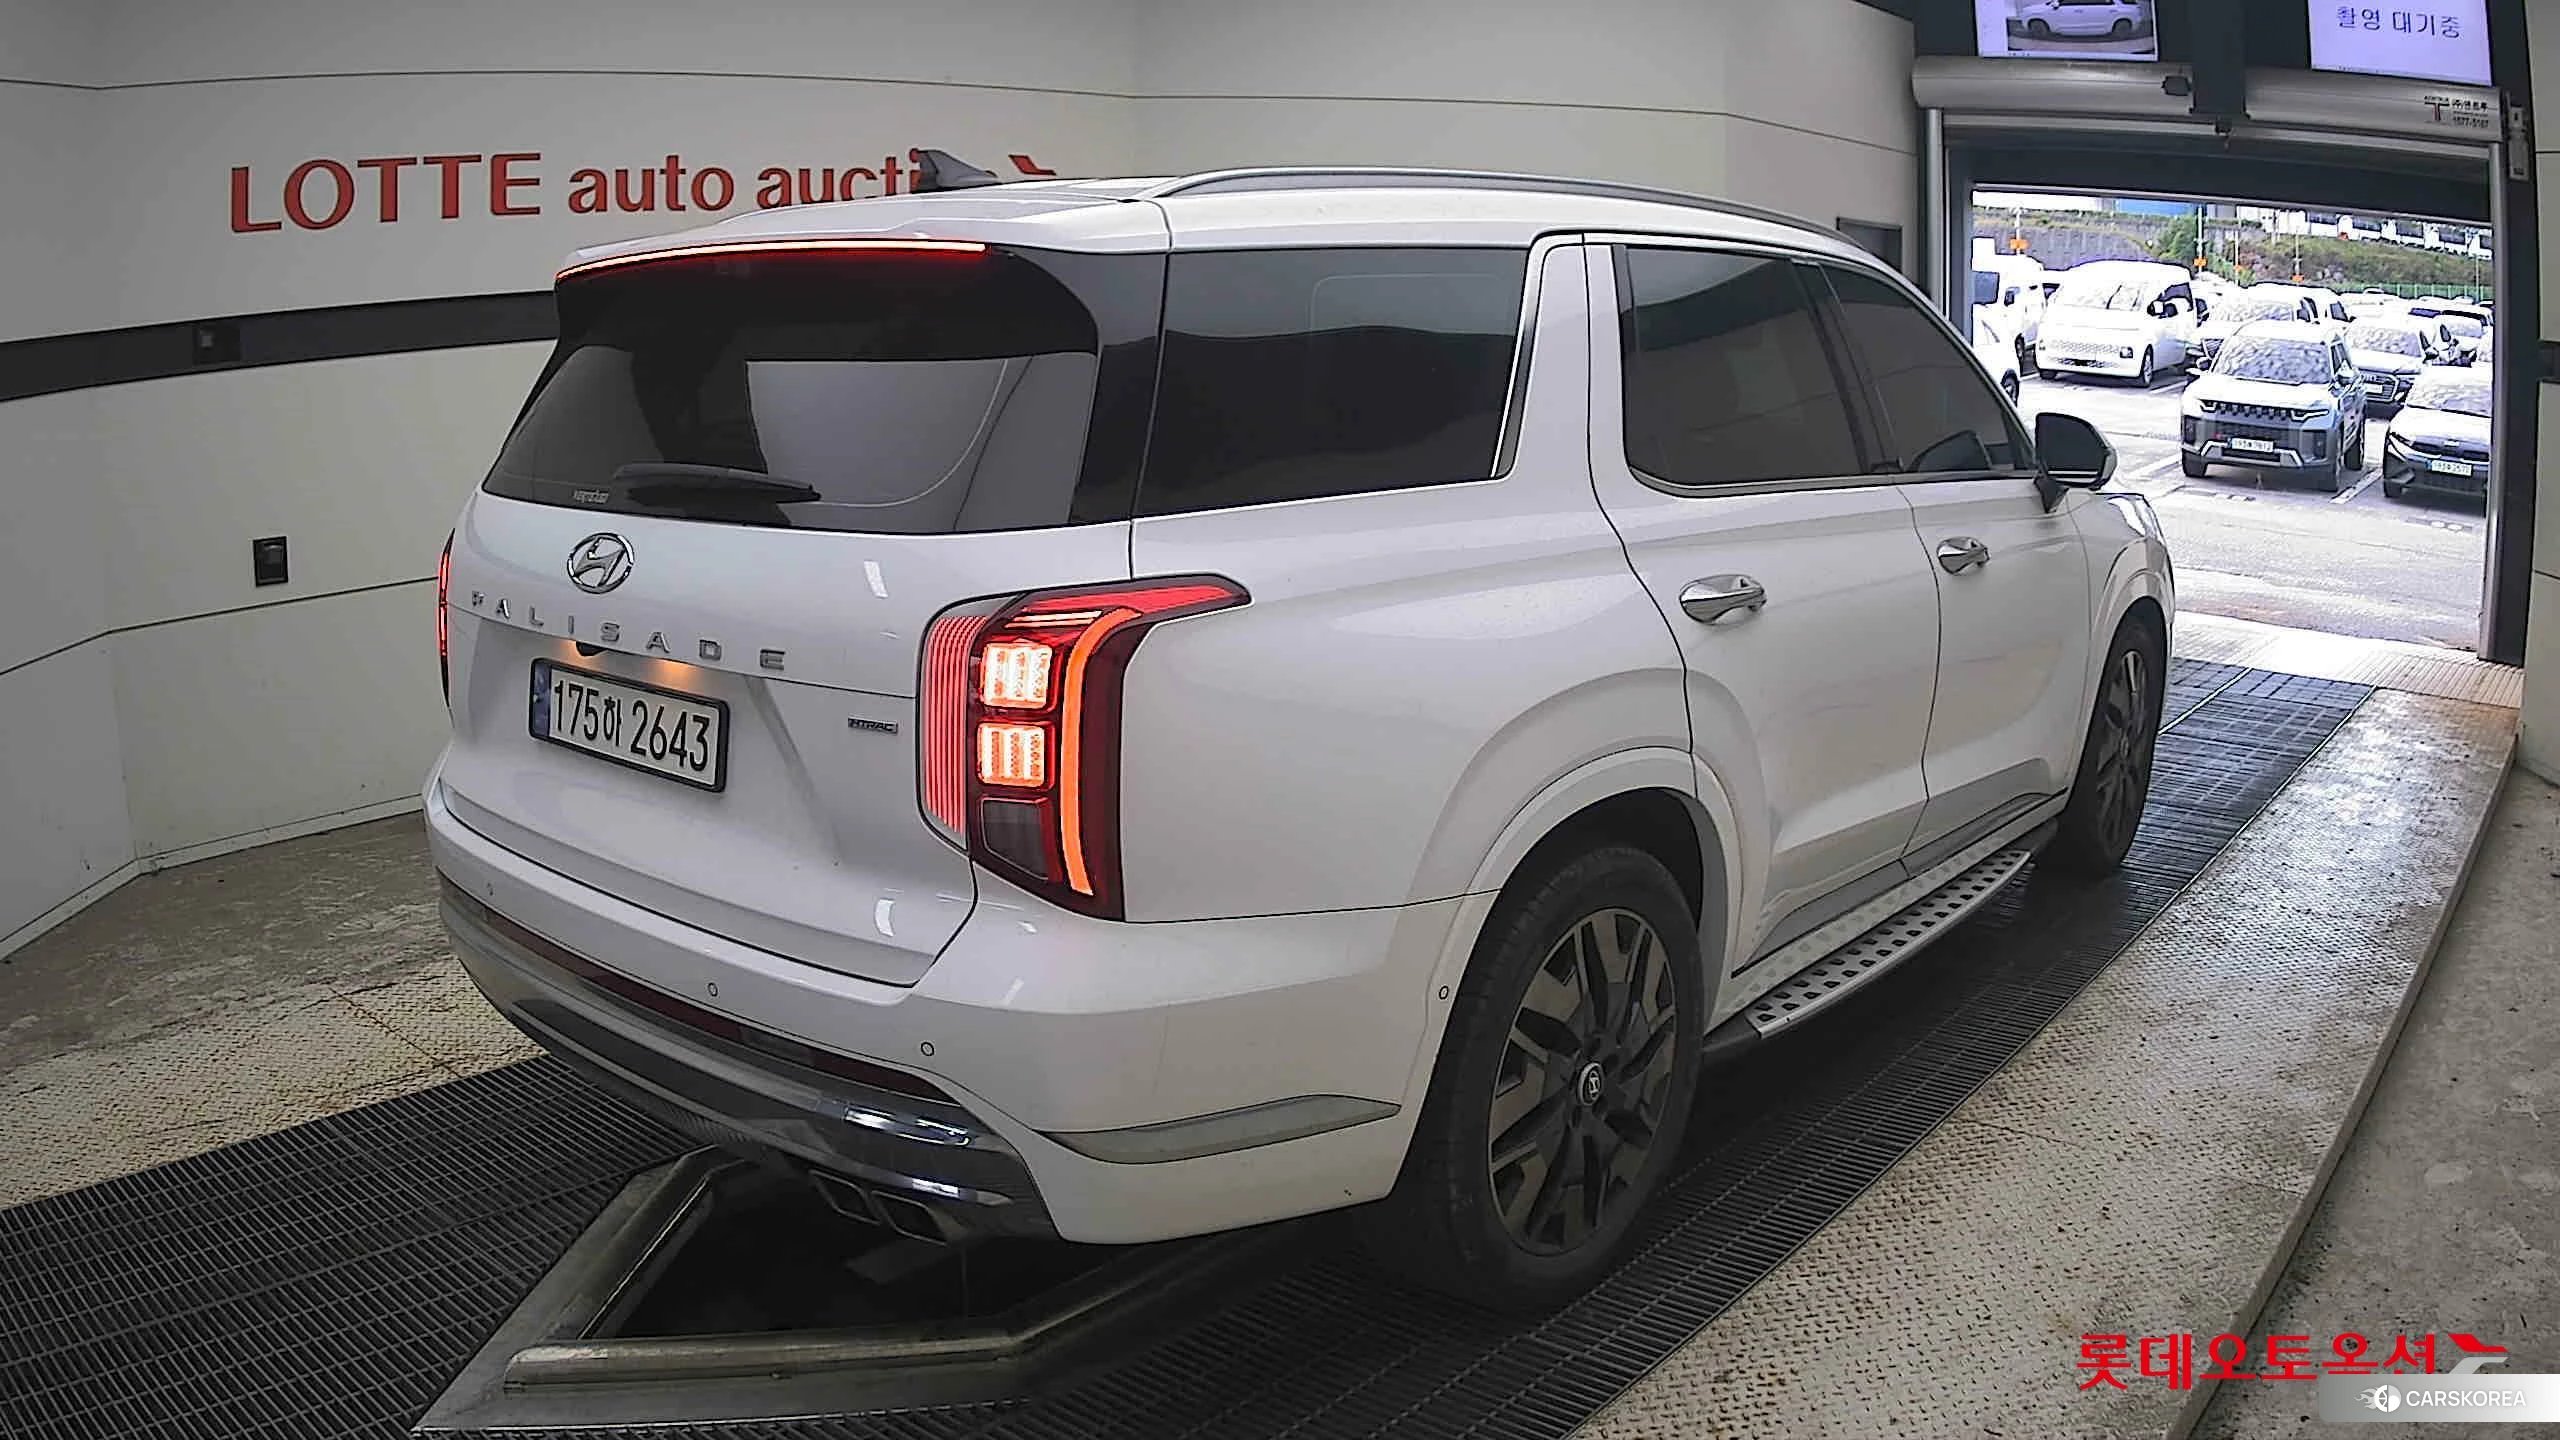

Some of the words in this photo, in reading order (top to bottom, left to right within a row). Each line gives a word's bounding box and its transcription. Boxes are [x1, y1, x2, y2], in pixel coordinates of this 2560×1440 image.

[2336, 5, 2382, 32] 촬영
[2391, 11, 2462, 39] 대기중
[230, 152, 542, 233] LOTTE
[567, 154, 736, 214] auto
[755, 148, 998, 211] aucti
[471, 589, 787, 672] PALISADE
[554, 679, 623, 747] 175하
[630, 699, 711, 772] 2643
